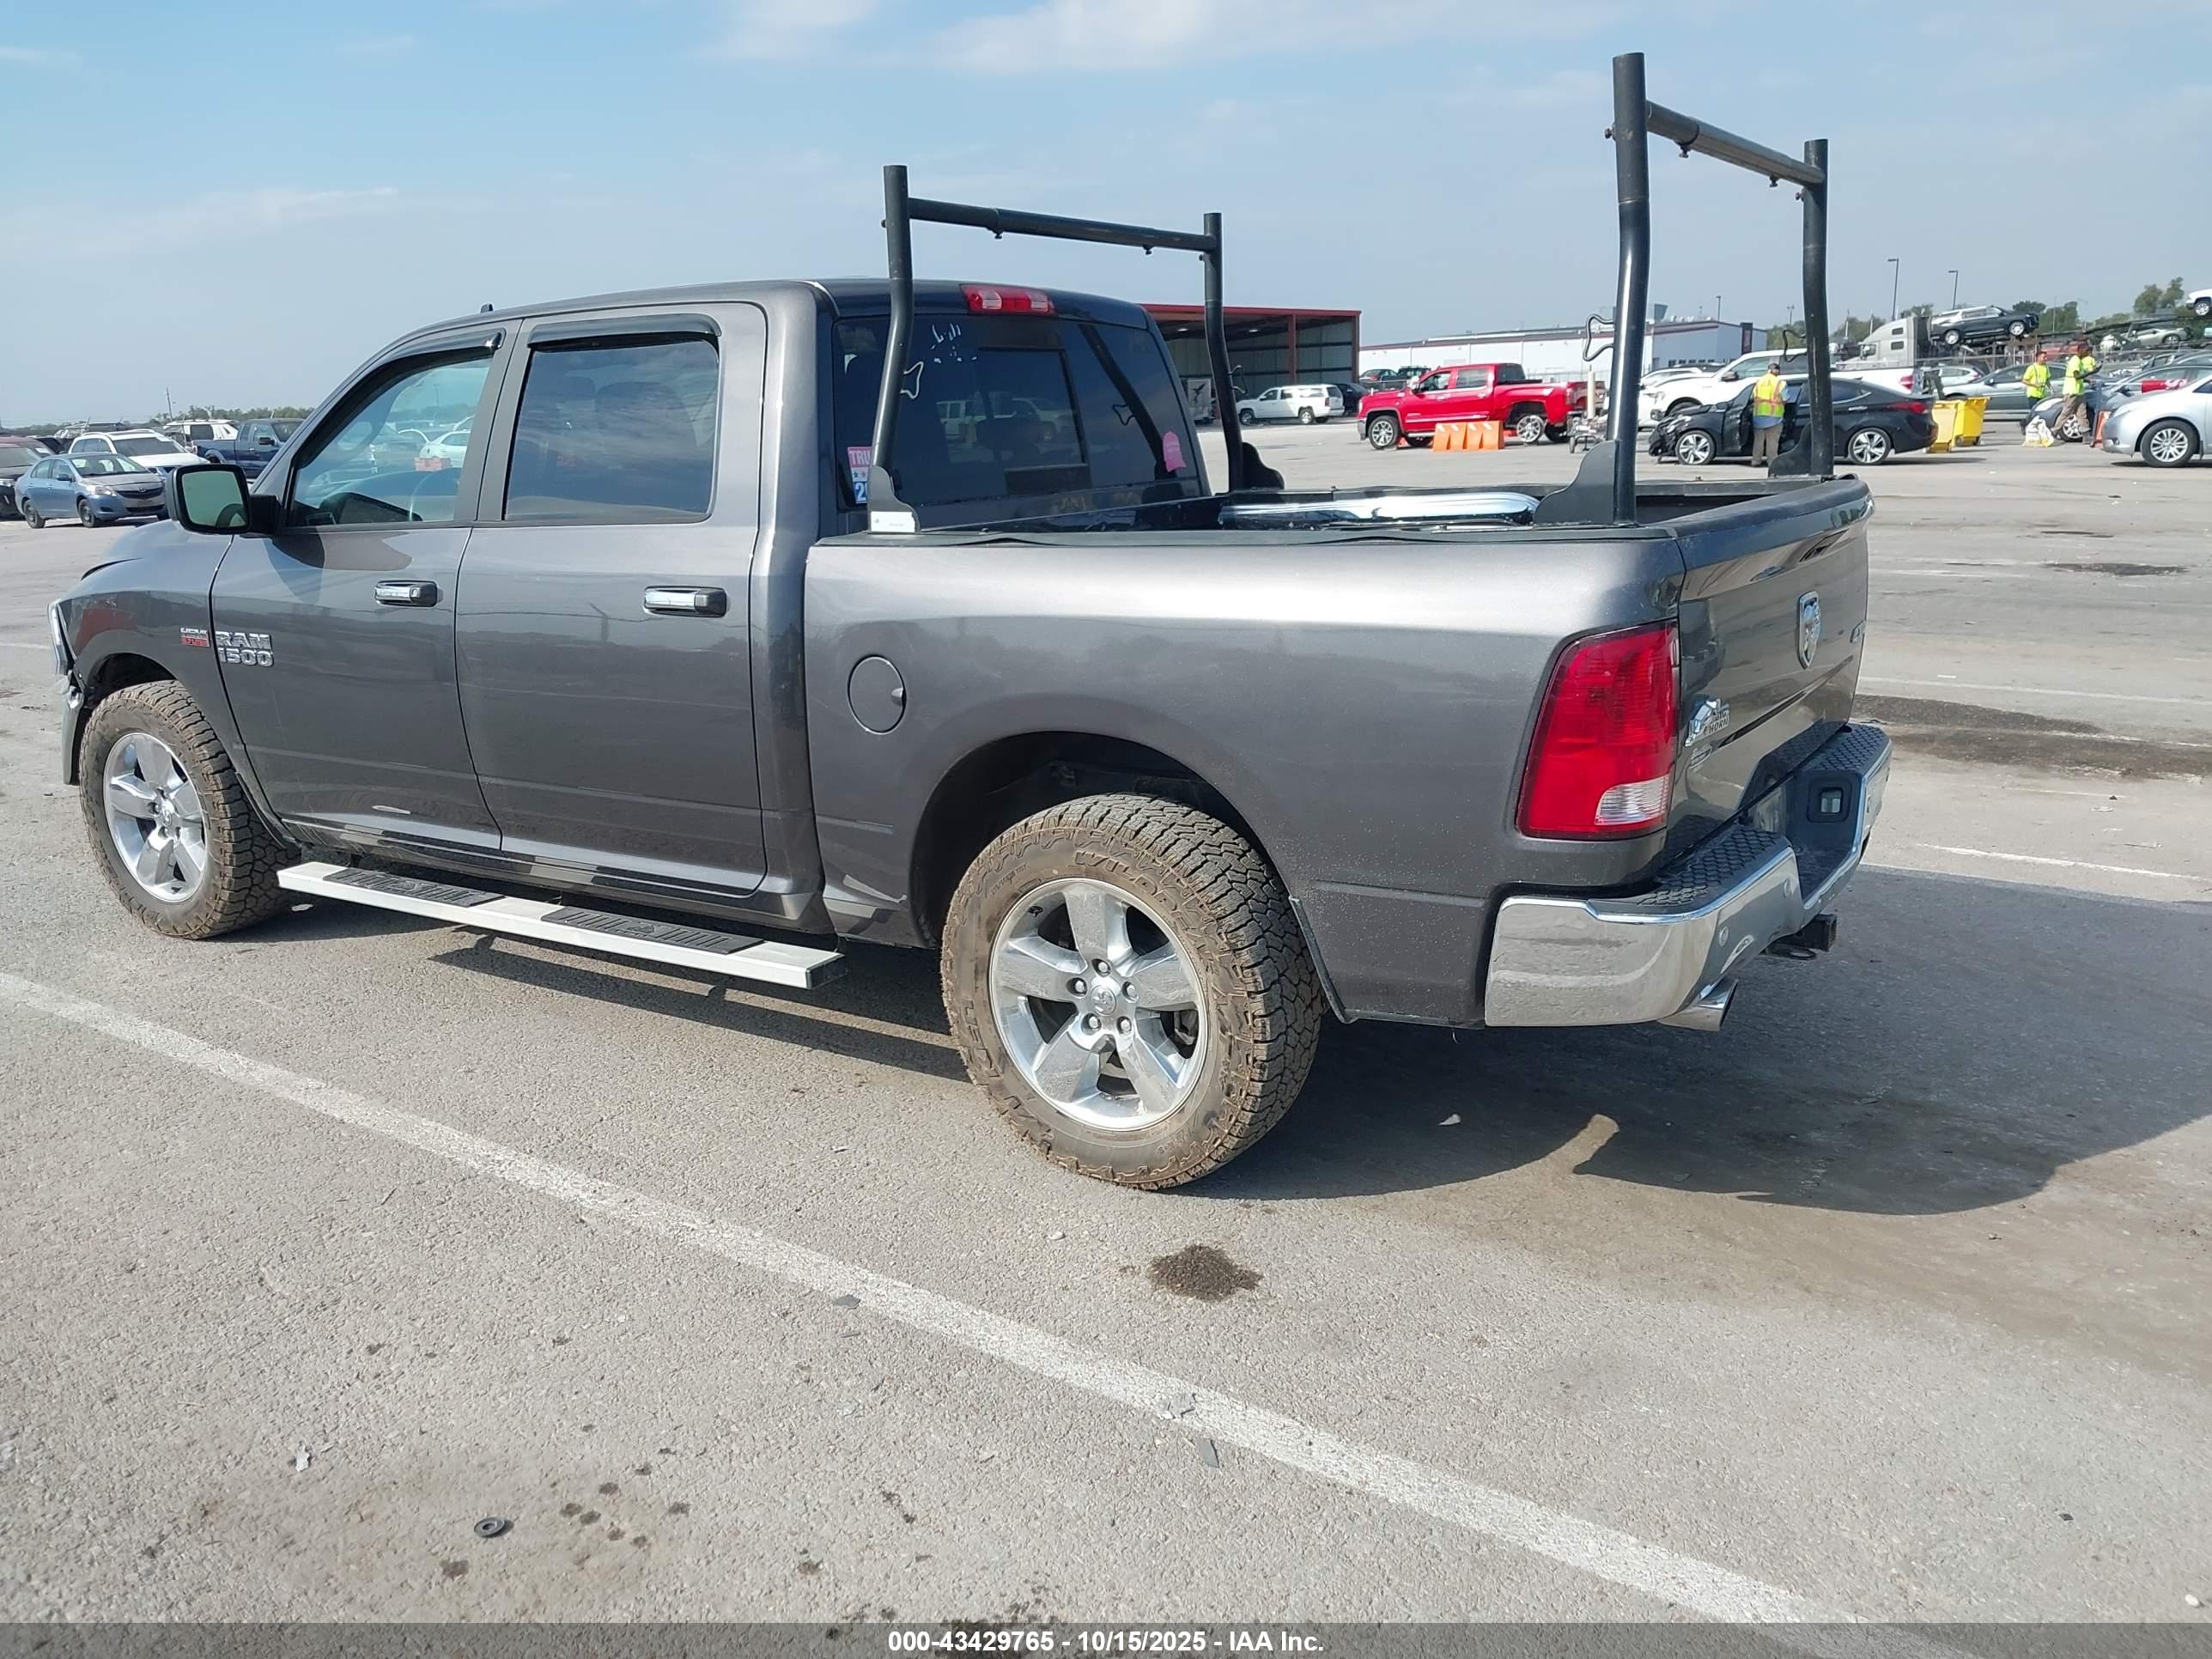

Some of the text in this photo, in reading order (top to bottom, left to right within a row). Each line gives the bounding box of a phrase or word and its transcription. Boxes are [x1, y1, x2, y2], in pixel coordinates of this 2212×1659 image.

[848, 450, 872, 465] TRU
[215, 631, 271, 649] RAM
[218, 647, 273, 667] 1500
[1709, 714, 1729, 733] HORN
